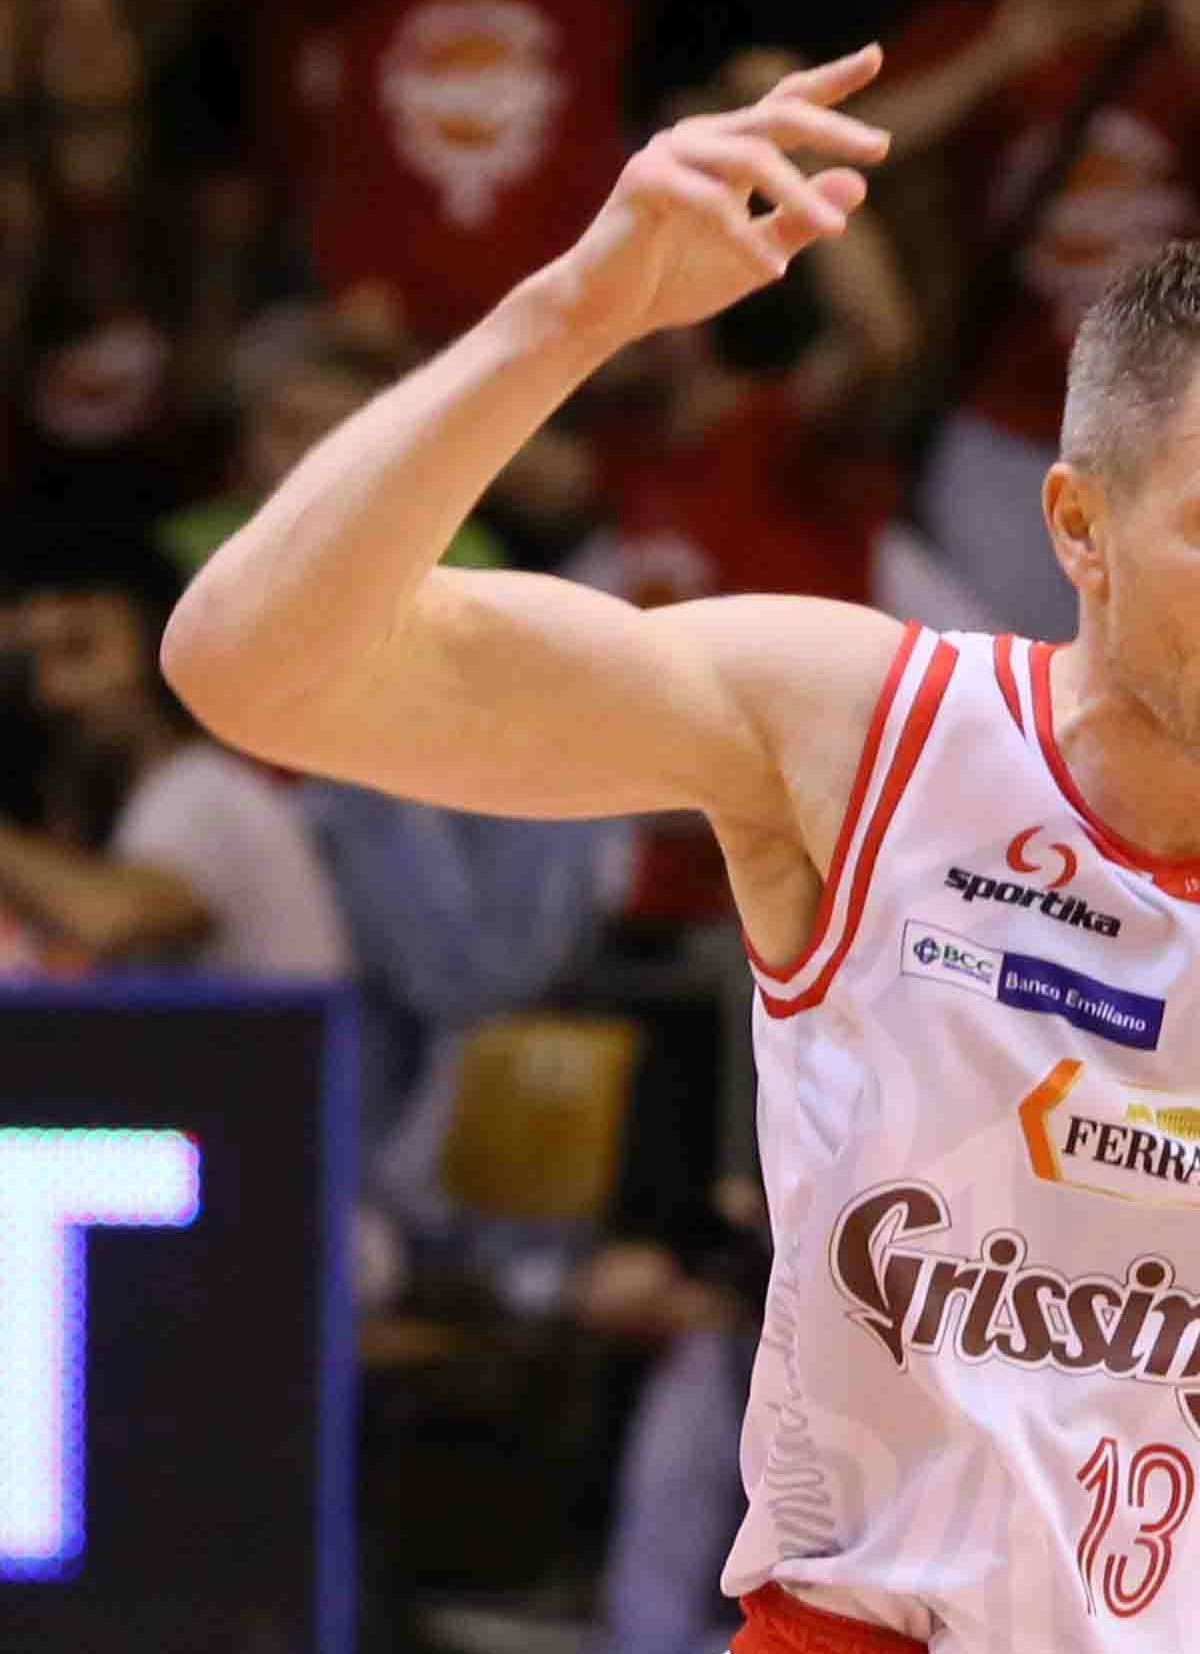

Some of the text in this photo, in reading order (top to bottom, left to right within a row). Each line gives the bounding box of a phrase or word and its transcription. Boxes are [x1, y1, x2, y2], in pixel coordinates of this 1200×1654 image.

[944, 866, 1122, 938] sportika
[943, 945, 994, 974] BCC
[1004, 970, 1061, 1001] Banco
[1064, 987, 1147, 1032] Emiliano
[1075, 1436, 1197, 1619] 13
